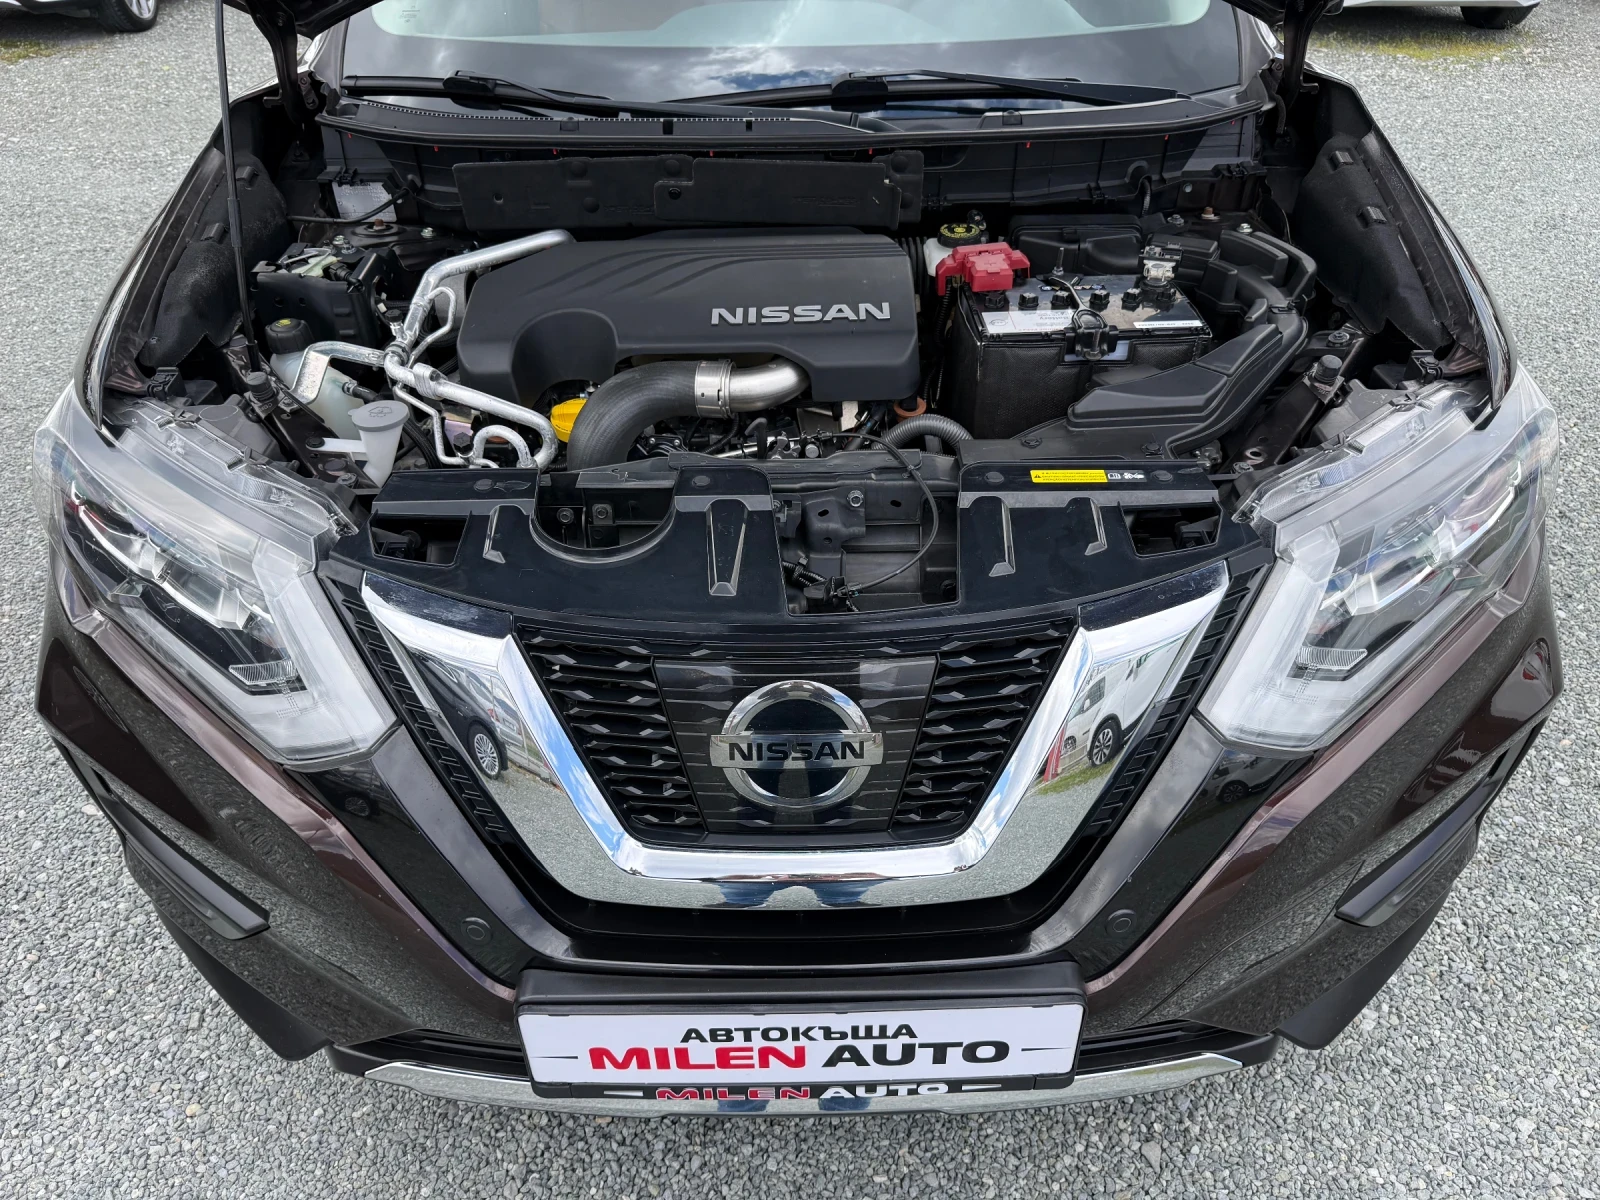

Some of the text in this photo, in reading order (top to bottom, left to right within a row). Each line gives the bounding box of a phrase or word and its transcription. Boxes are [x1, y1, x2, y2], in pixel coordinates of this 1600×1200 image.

[711, 302, 891, 325] NISSAN
[729, 741, 865, 761] NISSAN
[588, 1040, 1010, 1070] MILEN AUTO
[656, 1081, 949, 1100] MILEN AUTO
